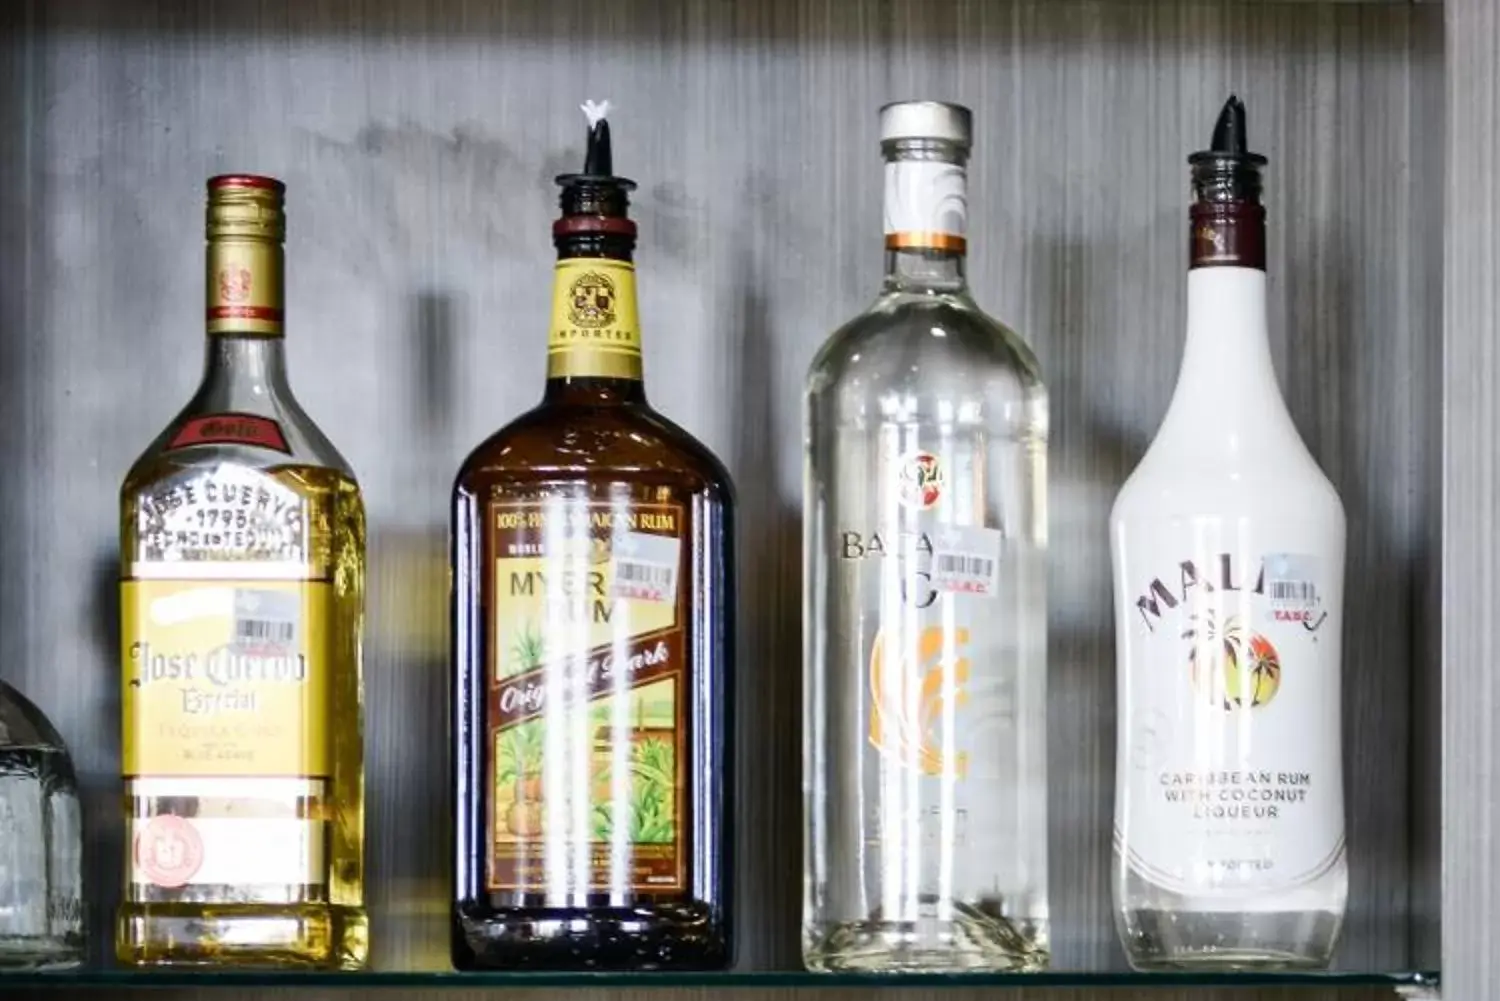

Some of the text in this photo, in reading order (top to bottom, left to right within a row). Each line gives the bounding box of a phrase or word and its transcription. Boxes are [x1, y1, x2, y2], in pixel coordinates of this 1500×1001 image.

[641, 513, 675, 530] RUM
[1160, 771, 1311, 786] CARIBBEAN RUM
[1218, 788, 1308, 803] COCONUT
[1193, 805, 1280, 819] LIQUEUR
